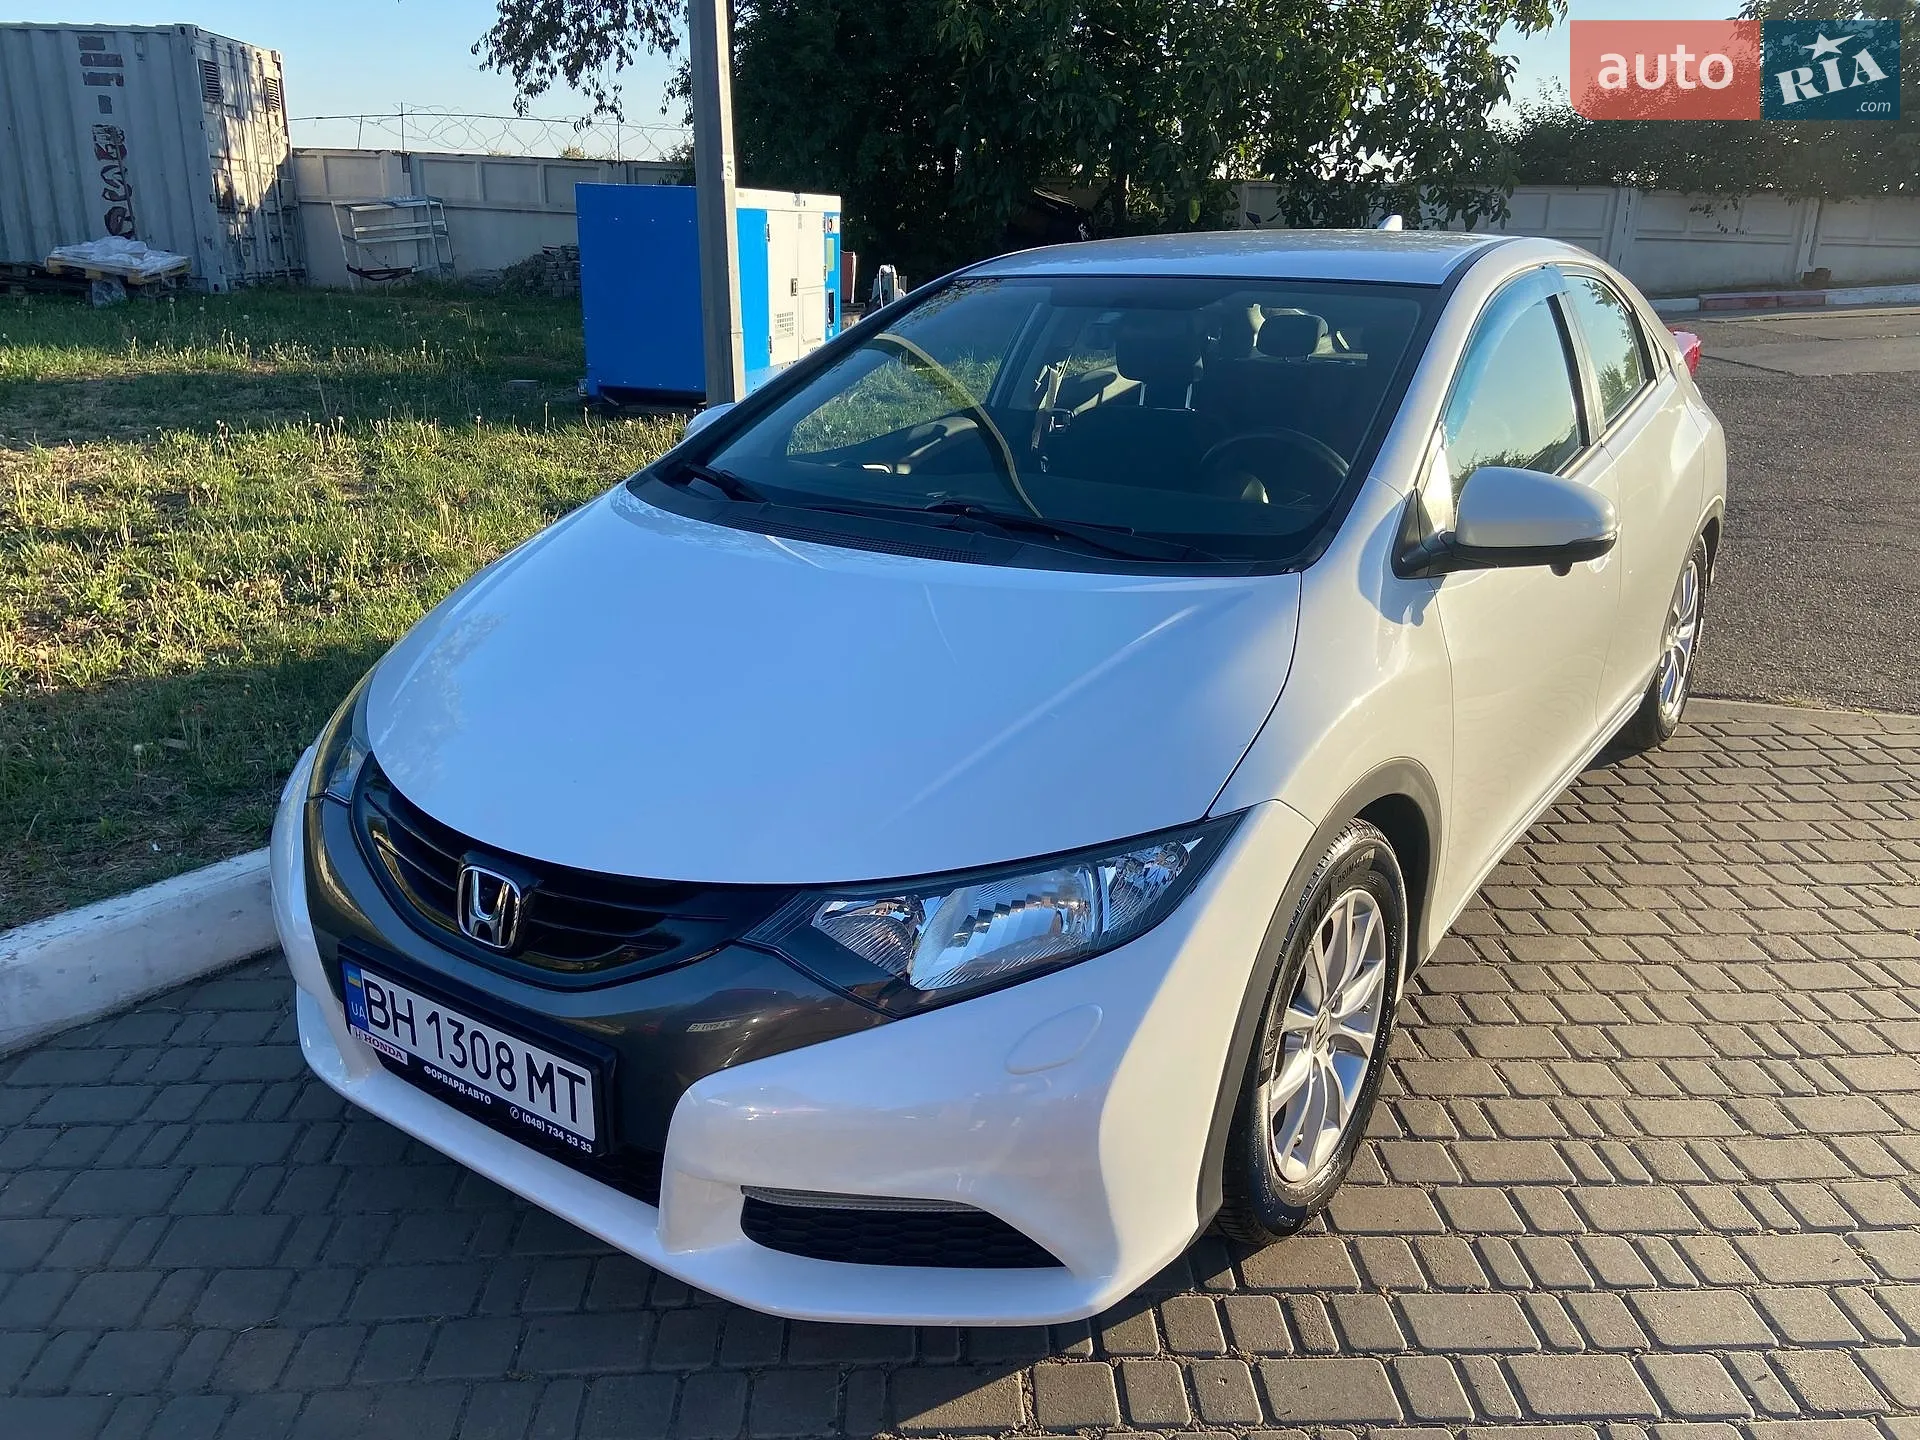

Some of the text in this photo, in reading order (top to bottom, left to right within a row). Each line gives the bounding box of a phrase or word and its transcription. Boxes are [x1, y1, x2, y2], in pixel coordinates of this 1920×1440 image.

[351, 1002, 366, 1020] UA
[363, 1033, 405, 1061] HONDA
[363, 978, 586, 1124] BH 1308 MT
[423, 1065, 492, 1105] ФОРВАРД-АВТО
[522, 1112, 592, 1154] (048) 734 33 33
